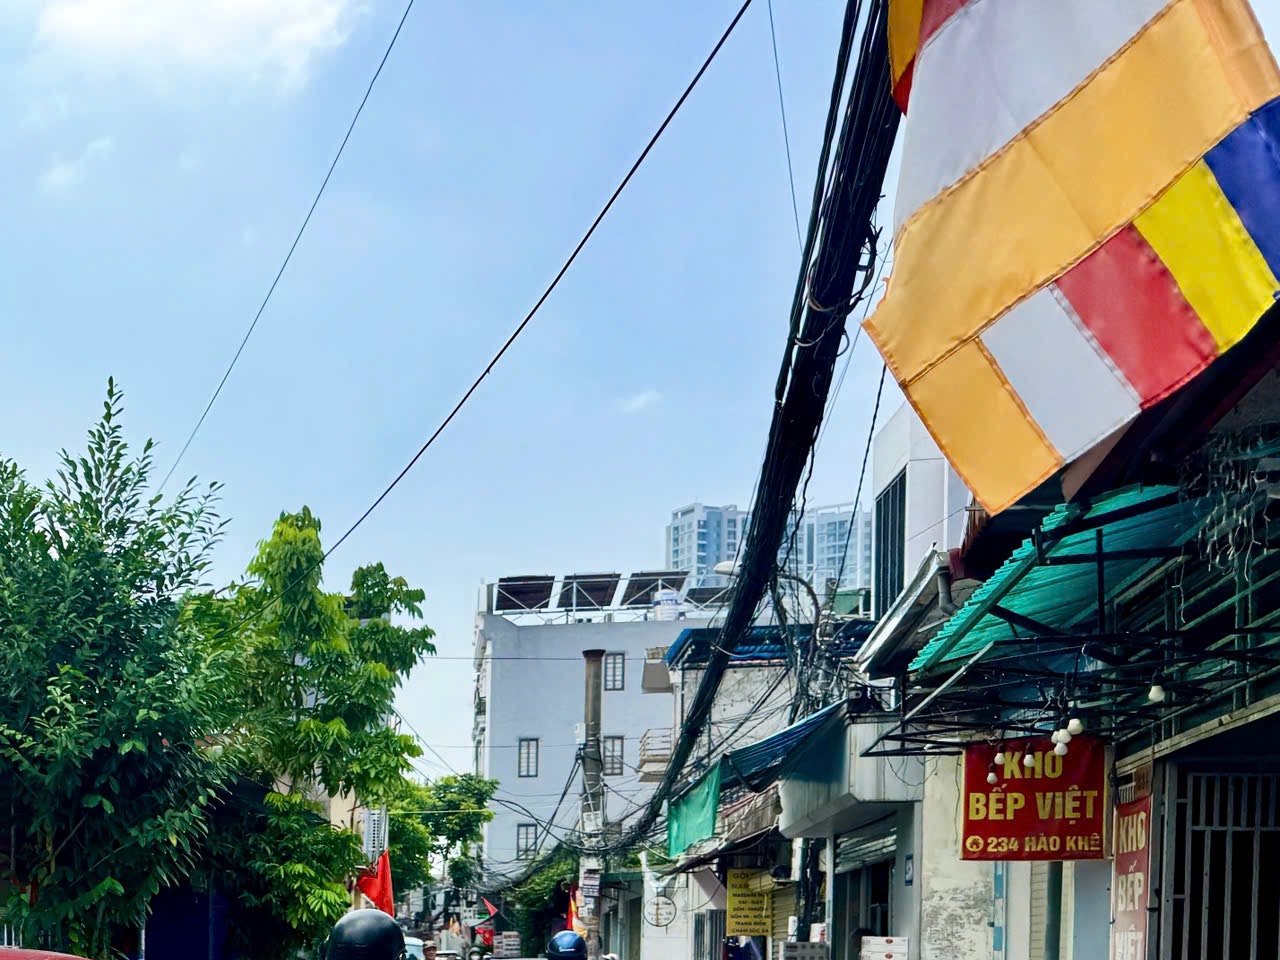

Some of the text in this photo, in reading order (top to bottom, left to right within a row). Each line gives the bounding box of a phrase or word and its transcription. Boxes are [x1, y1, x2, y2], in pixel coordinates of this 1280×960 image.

[1003, 750, 1063, 779] KHO
[968, 783, 1098, 824] BẾP VIỆT
[986, 836, 1019, 852] 234
[1066, 832, 1101, 851] KHÊ
[1119, 811, 1146, 853] KHO
